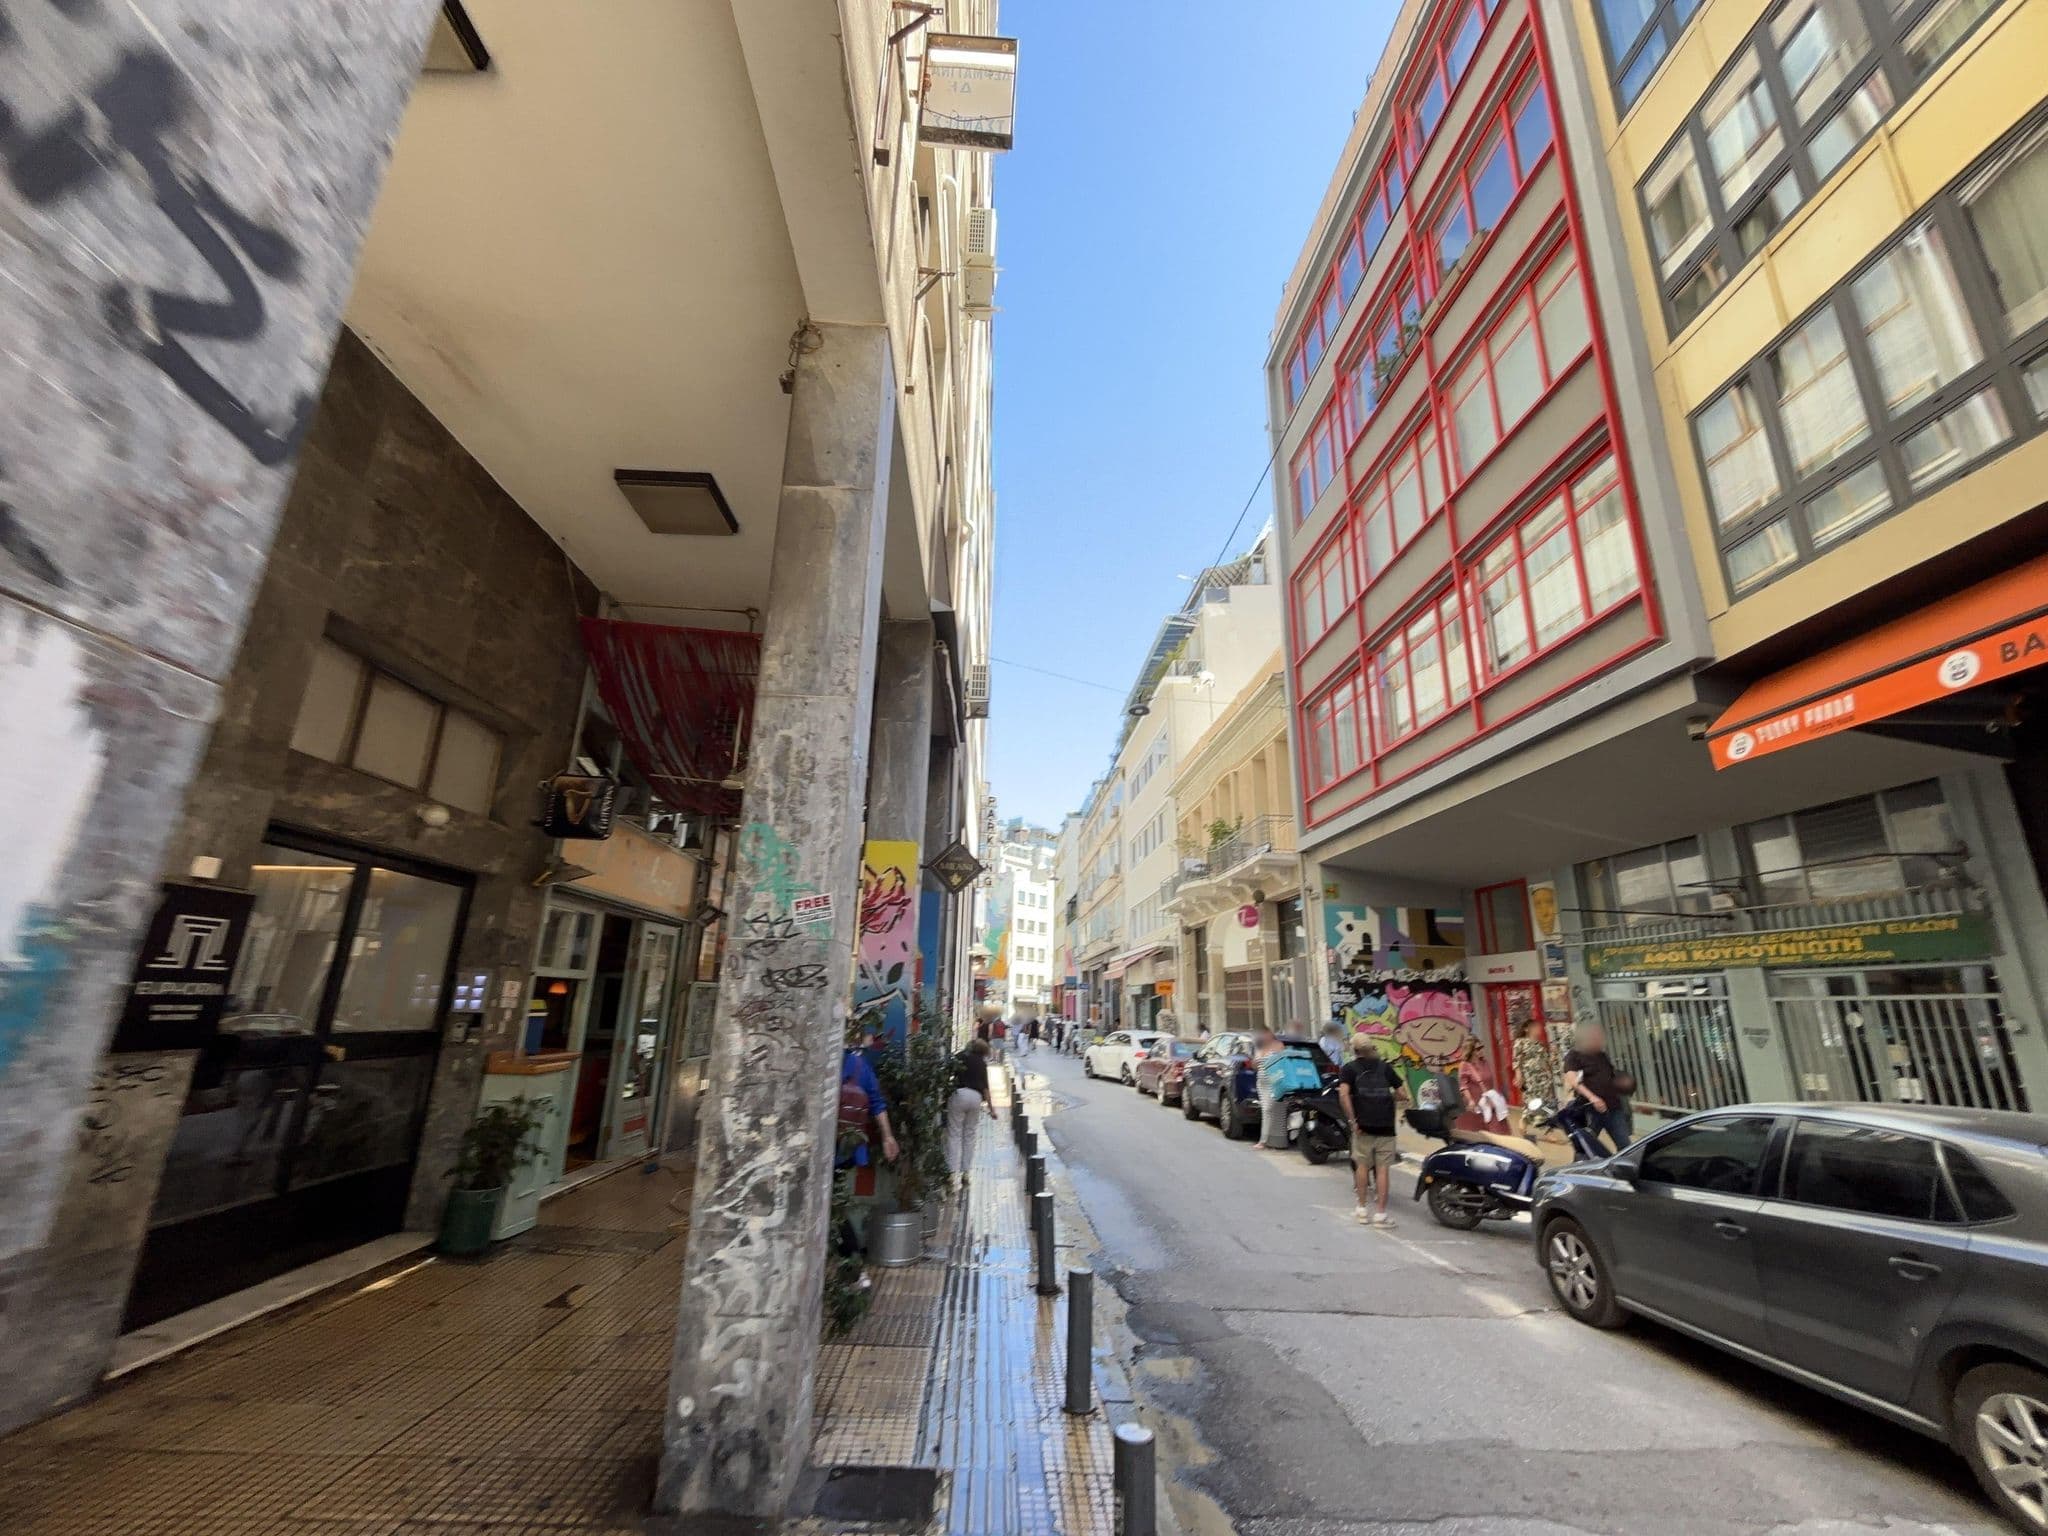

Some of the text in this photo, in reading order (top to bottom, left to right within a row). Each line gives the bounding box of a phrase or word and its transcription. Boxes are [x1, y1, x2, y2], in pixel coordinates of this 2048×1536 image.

[984, 796, 996, 886] PARKING
[794, 894, 831, 911] FREE
[1692, 936, 1864, 961] ΚΟΥΡΟΥΝΙΩΤΗ
